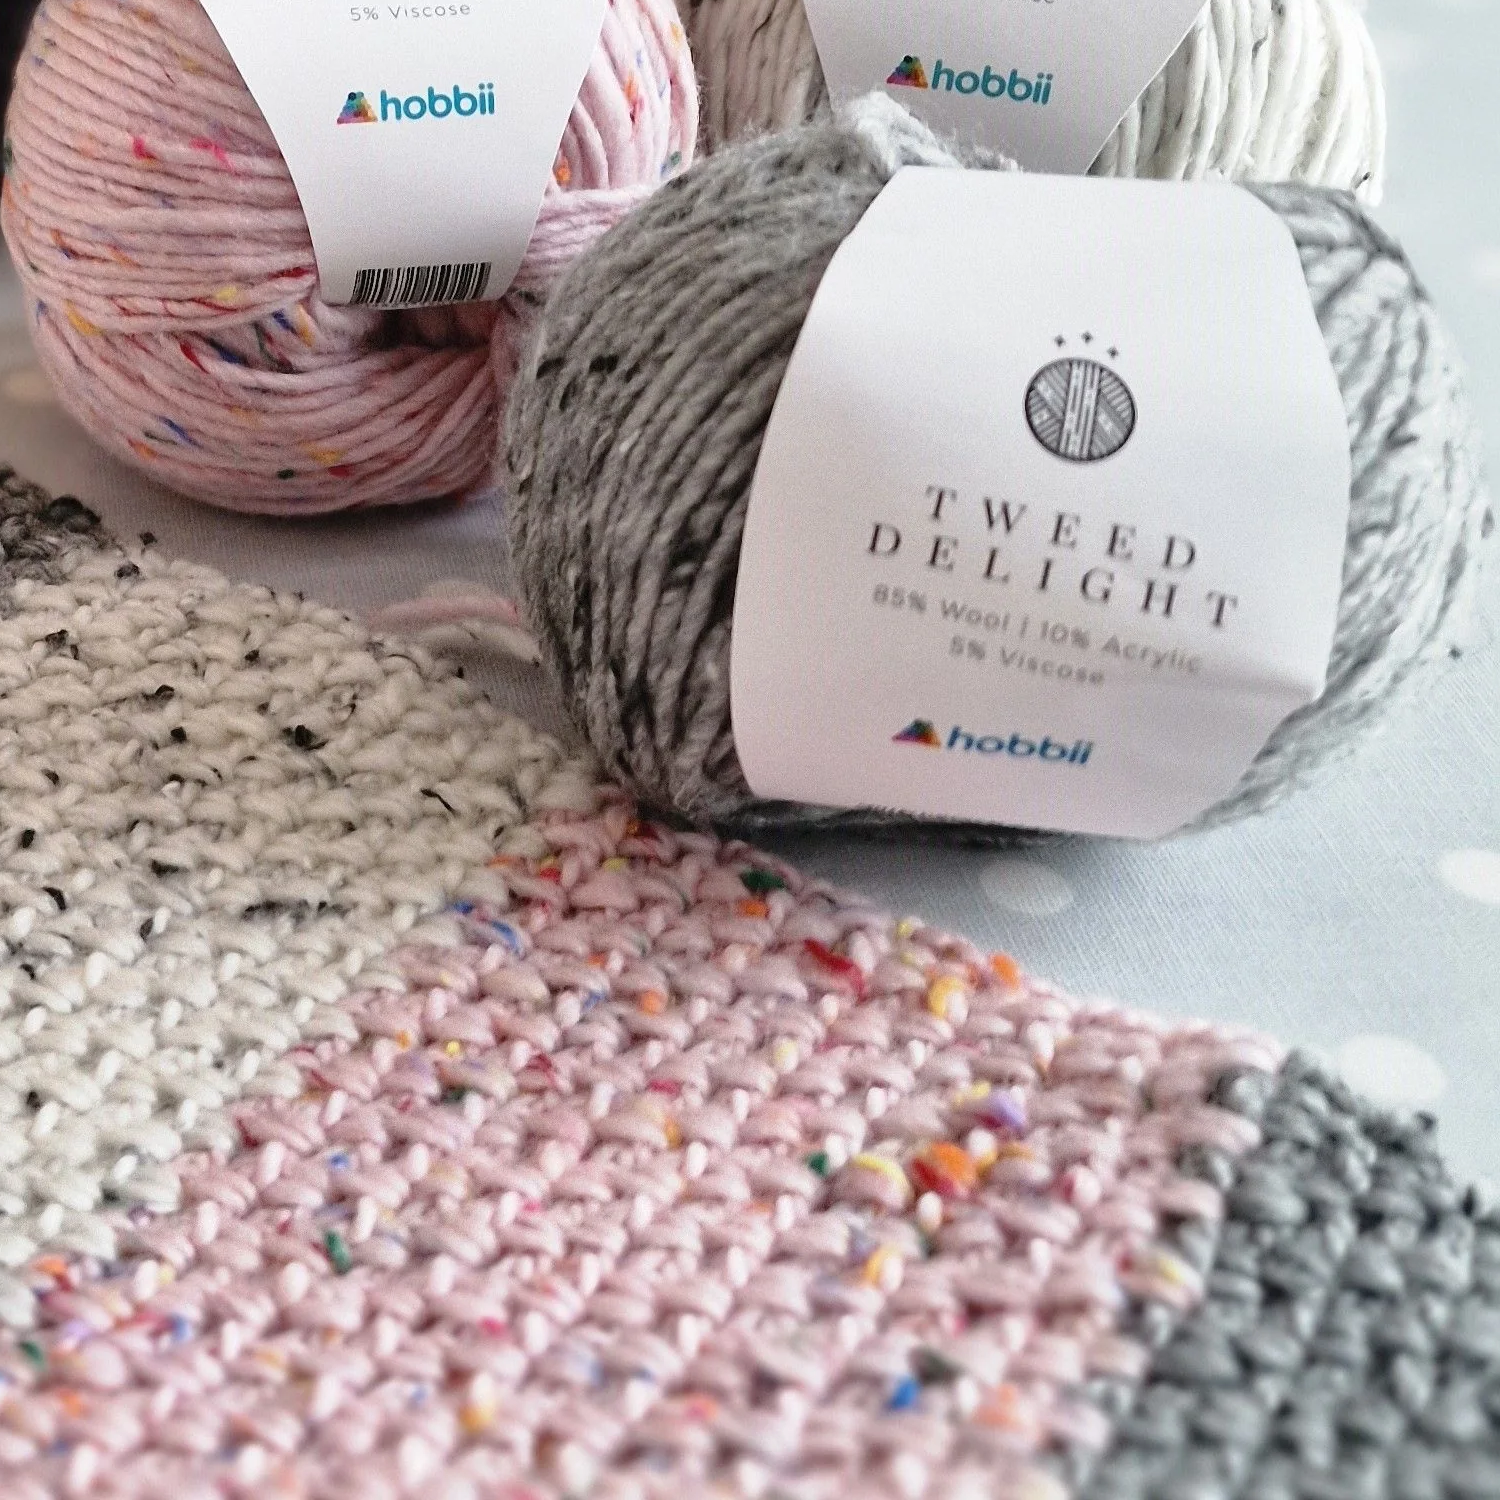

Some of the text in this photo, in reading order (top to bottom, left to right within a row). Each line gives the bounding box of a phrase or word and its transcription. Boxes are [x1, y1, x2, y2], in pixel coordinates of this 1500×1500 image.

[350, 2, 471, 21] 5% Viscose
[380, 83, 495, 121] hobbii
[931, 59, 1053, 105] hobbii
[925, 485, 1196, 569] TWEED
[868, 522, 1238, 628] DELIGHT
[873, 584, 925, 615] 85%
[940, 598, 1009, 631] Wool
[1041, 621, 1091, 649] 10%
[1102, 634, 1199, 673] Acrylic
[950, 636, 1105, 685] 5% Viscose
[946, 726, 1092, 765] hobbii
